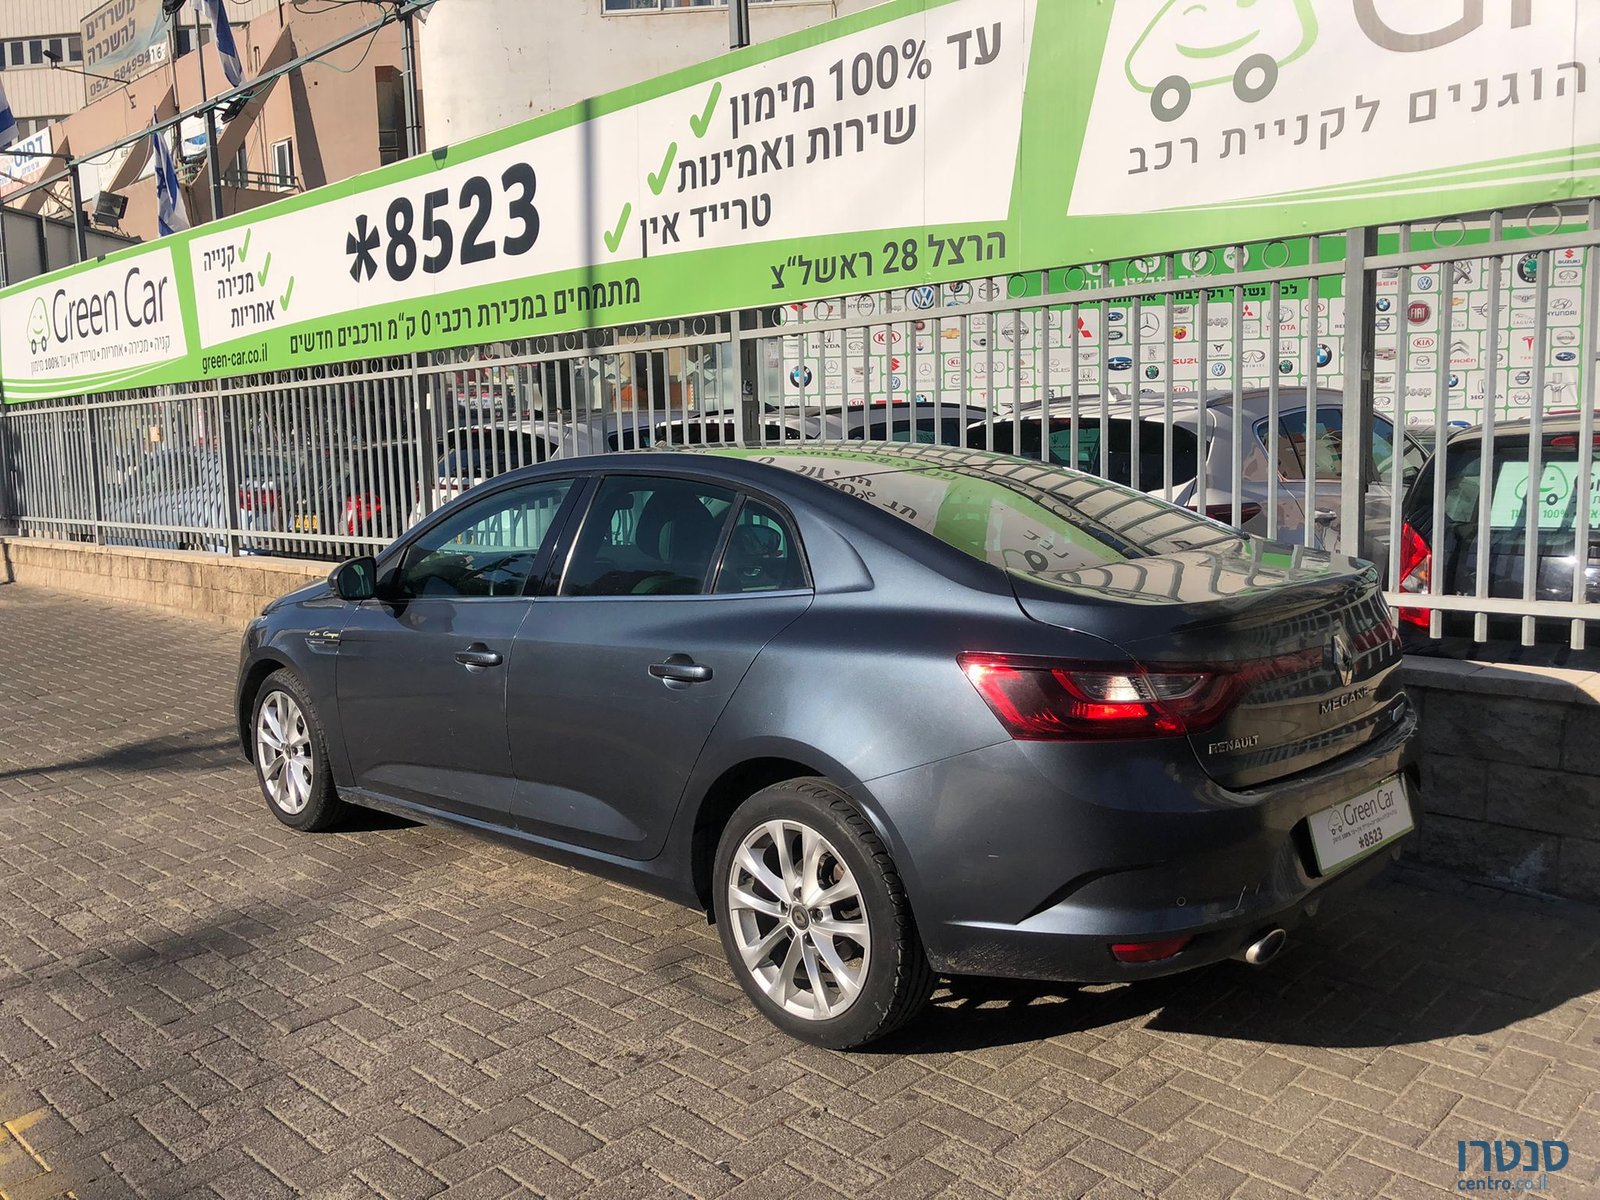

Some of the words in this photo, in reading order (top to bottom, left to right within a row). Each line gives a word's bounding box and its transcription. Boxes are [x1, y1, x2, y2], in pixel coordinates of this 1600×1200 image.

[87, 17, 136, 66] להשכרה
[947, 21, 1001, 70] עד
[829, 39, 931, 101] 100%
[729, 76, 814, 139] מימון
[1408, 56, 1600, 124] הוגנים
[806, 104, 916, 164] שירות
[1219, 94, 1381, 159] לקניית
[678, 134, 794, 193] ואמינות
[1128, 136, 1198, 175] רכב
[690, 193, 771, 238] טרייד
[640, 212, 680, 258] אין
[928, 231, 1006, 267] הרצל
[203, 244, 235, 272] קנייה
[883, 239, 917, 273] 28
[217, 272, 254, 299] מכירה
[554, 276, 640, 314] מתמחים
[53, 289, 118, 343] Green
[124, 267, 167, 327] Car
[230, 300, 275, 328] אחריות
[436, 308, 471, 334] רכבי
[477, 294, 547, 327] במכירת
[1410, 307, 1425, 319] FIAT
[338, 320, 382, 346] ורכבים
[421, 310, 431, 336] 0
[877, 333, 897, 342] KA
[1266, 324, 1296, 332] TOTA
[202, 343, 268, 374] green-car.co.il
[290, 330, 333, 354] חדשים
[1416, 338, 1431, 346] KIA
[1208, 734, 1260, 755] RENAULT
[1343, 800, 1378, 826] Green
[1376, 789, 1395, 810] Car
